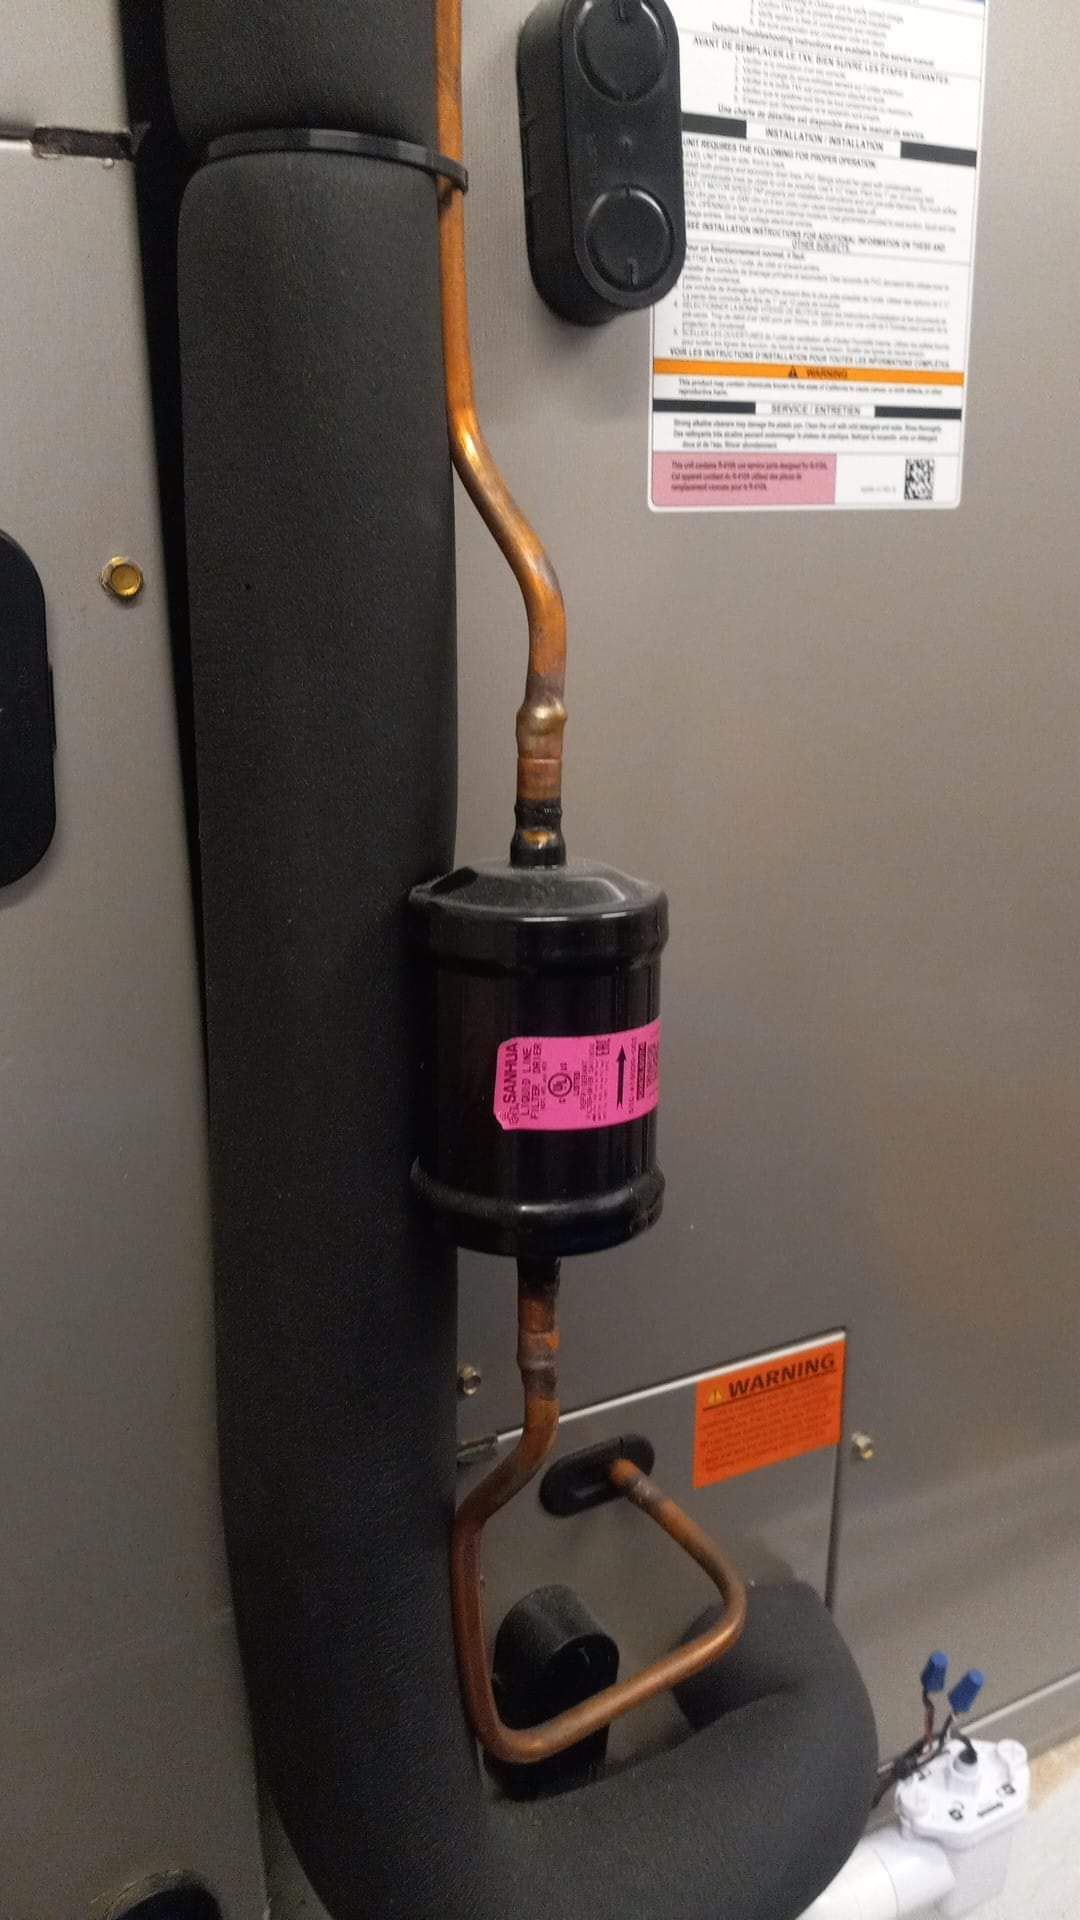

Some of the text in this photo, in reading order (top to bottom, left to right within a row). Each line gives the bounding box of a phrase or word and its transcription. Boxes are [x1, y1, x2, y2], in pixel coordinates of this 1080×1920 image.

[694, 36, 718, 48] AVANT
[722, 40, 732, 50] DE
[736, 43, 784, 59] REMPLACER
[786, 49, 796, 60] LE
[816, 54, 834, 67] BIEN
[836, 57, 863, 71] SUIVRE
[864, 62, 879, 74] LES
[718, 103, 732, 114] Une
[766, 128, 823, 144] INSTALLATION
[830, 135, 884, 151] INSTALLATION
[701, 140, 736, 152] REQUIRES
[740, 144, 750, 154] THE
[754, 146, 794, 158] FOLLOWING
[796, 150, 808, 160] FOR
[810, 152, 837, 164] PROPER
[688, 220, 700, 230] SEE
[702, 223, 750, 234] INSTALLATION
[752, 227, 801, 239] INSTRUCTIONS
[803, 232, 816, 241] FOR
[818, 232, 854, 245] ADDITIONAL
[858, 236, 900, 248] INFORMATION
[670, 348, 686, 356] VOIR
[689, 348, 702, 356] LES
[704, 348, 754, 359] INSTRUCTIONS
[756, 350, 807, 361] D'INSTALLATION
[810, 354, 827, 362] POUR
[855, 356, 866, 364] LES
[806, 368, 848, 379] WARNING
[679, 378, 690, 386] This
[692, 379, 712, 388] product
[726, 380, 745, 388] contain
[746, 381, 772, 389] chemicals
[773, 382, 790, 390] known
[679, 388, 712, 396] reproductive
[771, 402, 808, 415] SERVICE
[815, 404, 860, 416] ENTRETIEN
[674, 418, 692, 428] Strong
[693, 419, 712, 427] alkaline
[713, 420, 734, 428] cleaners
[748, 420, 766, 430] damage
[672, 460, 682, 469] This
[503, 1042, 518, 1104] SANHUA
[520, 1047, 532, 1116] LIQUID LINE
[530, 1042, 542, 1120] FILTER DRIER
[728, 1353, 835, 1398] WARNING
